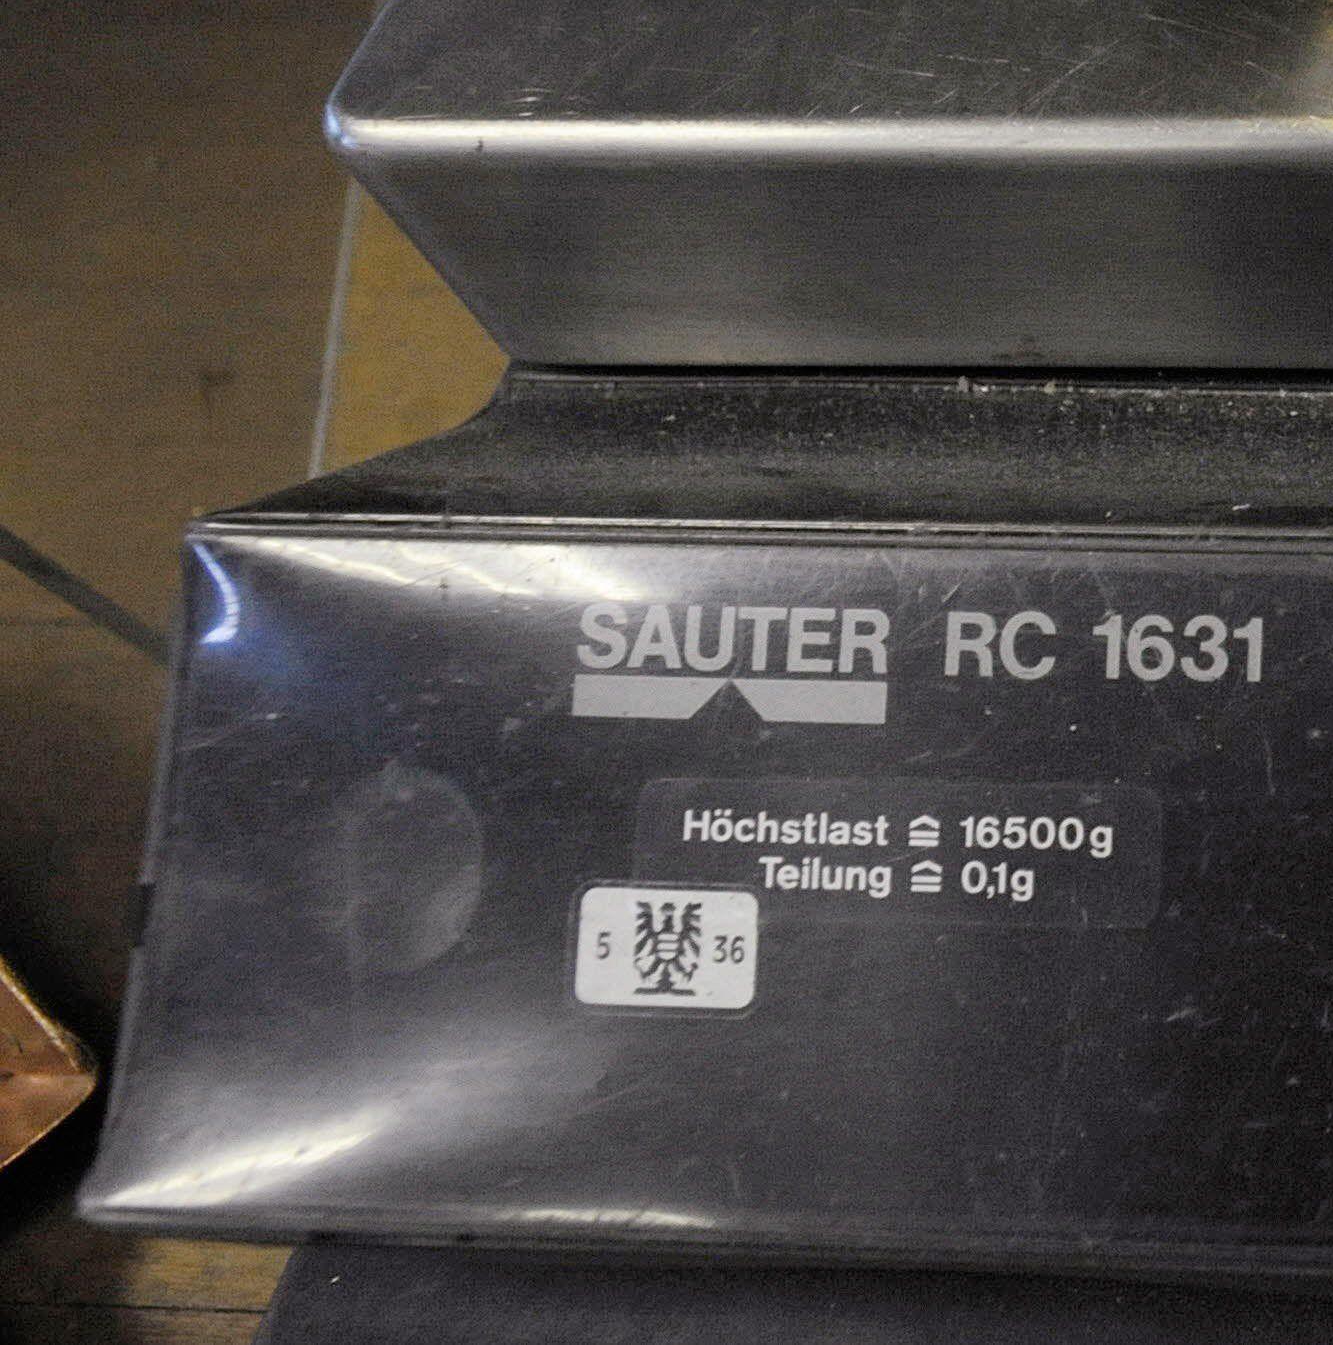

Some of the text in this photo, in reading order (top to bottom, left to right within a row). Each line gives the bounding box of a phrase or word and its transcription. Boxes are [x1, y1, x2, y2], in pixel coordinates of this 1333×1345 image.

[576, 605, 891, 675] SAUTER
[944, 610, 1264, 683] RC 1631
[682, 808, 889, 847] Höchstlast
[757, 856, 1035, 903] Teilung 0,1g
[596, 930, 746, 964] 5 36
